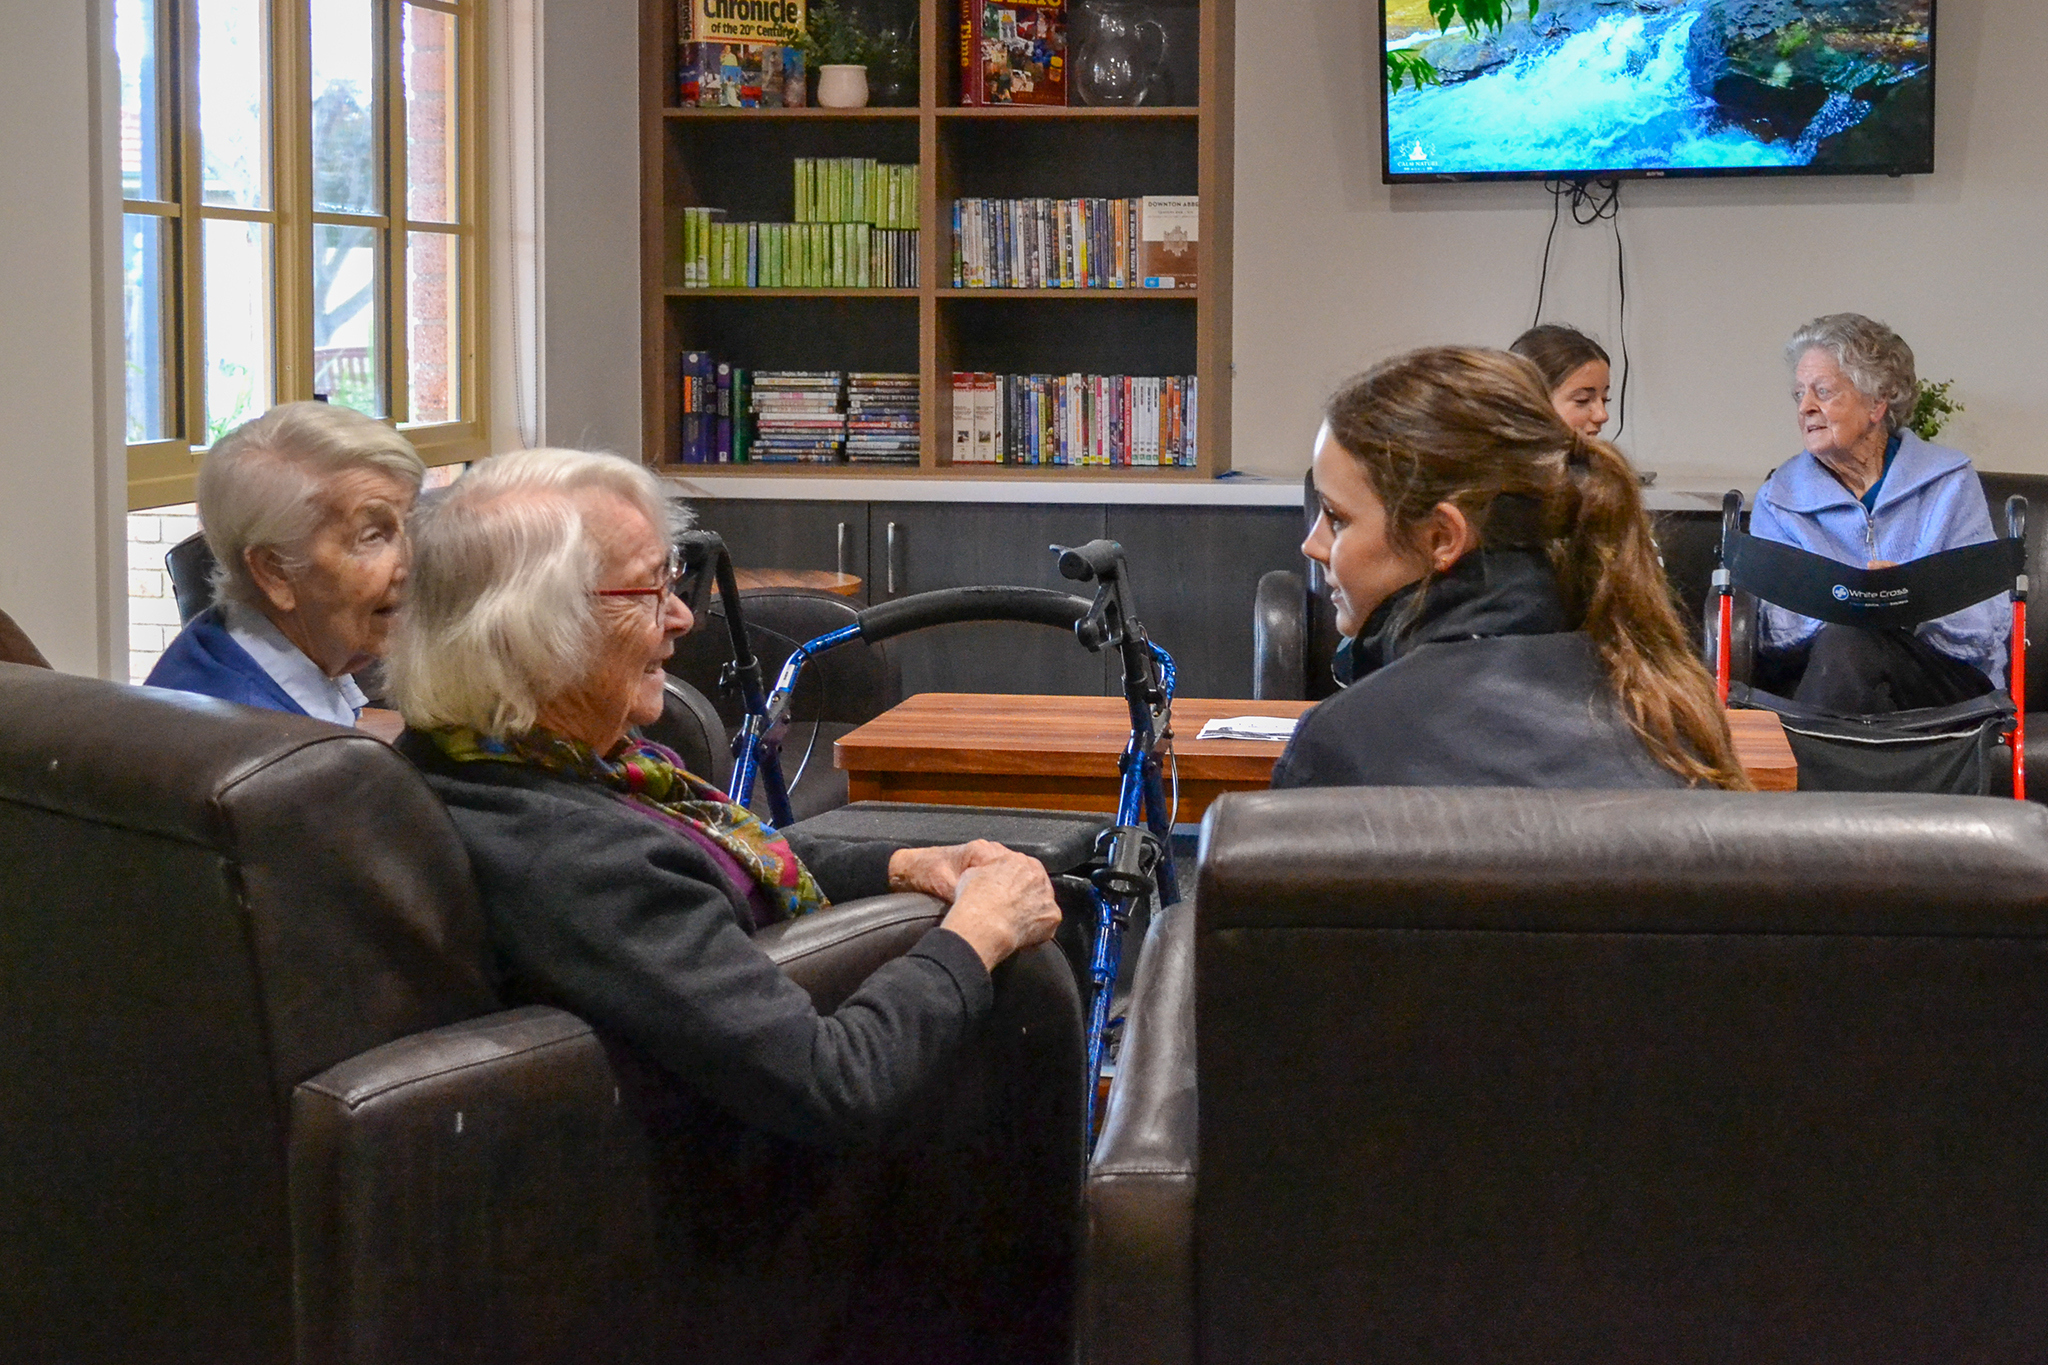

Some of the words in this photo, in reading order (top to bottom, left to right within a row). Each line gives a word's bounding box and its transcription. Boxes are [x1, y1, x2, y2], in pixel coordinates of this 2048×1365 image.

[703, 0, 798, 23] Chronicle
[711, 22, 721, 33] of
[723, 23, 738, 35] the
[1065, 223, 1073, 263] LION
[1849, 589, 1878, 598] White
[1880, 587, 1908, 598] Cross
